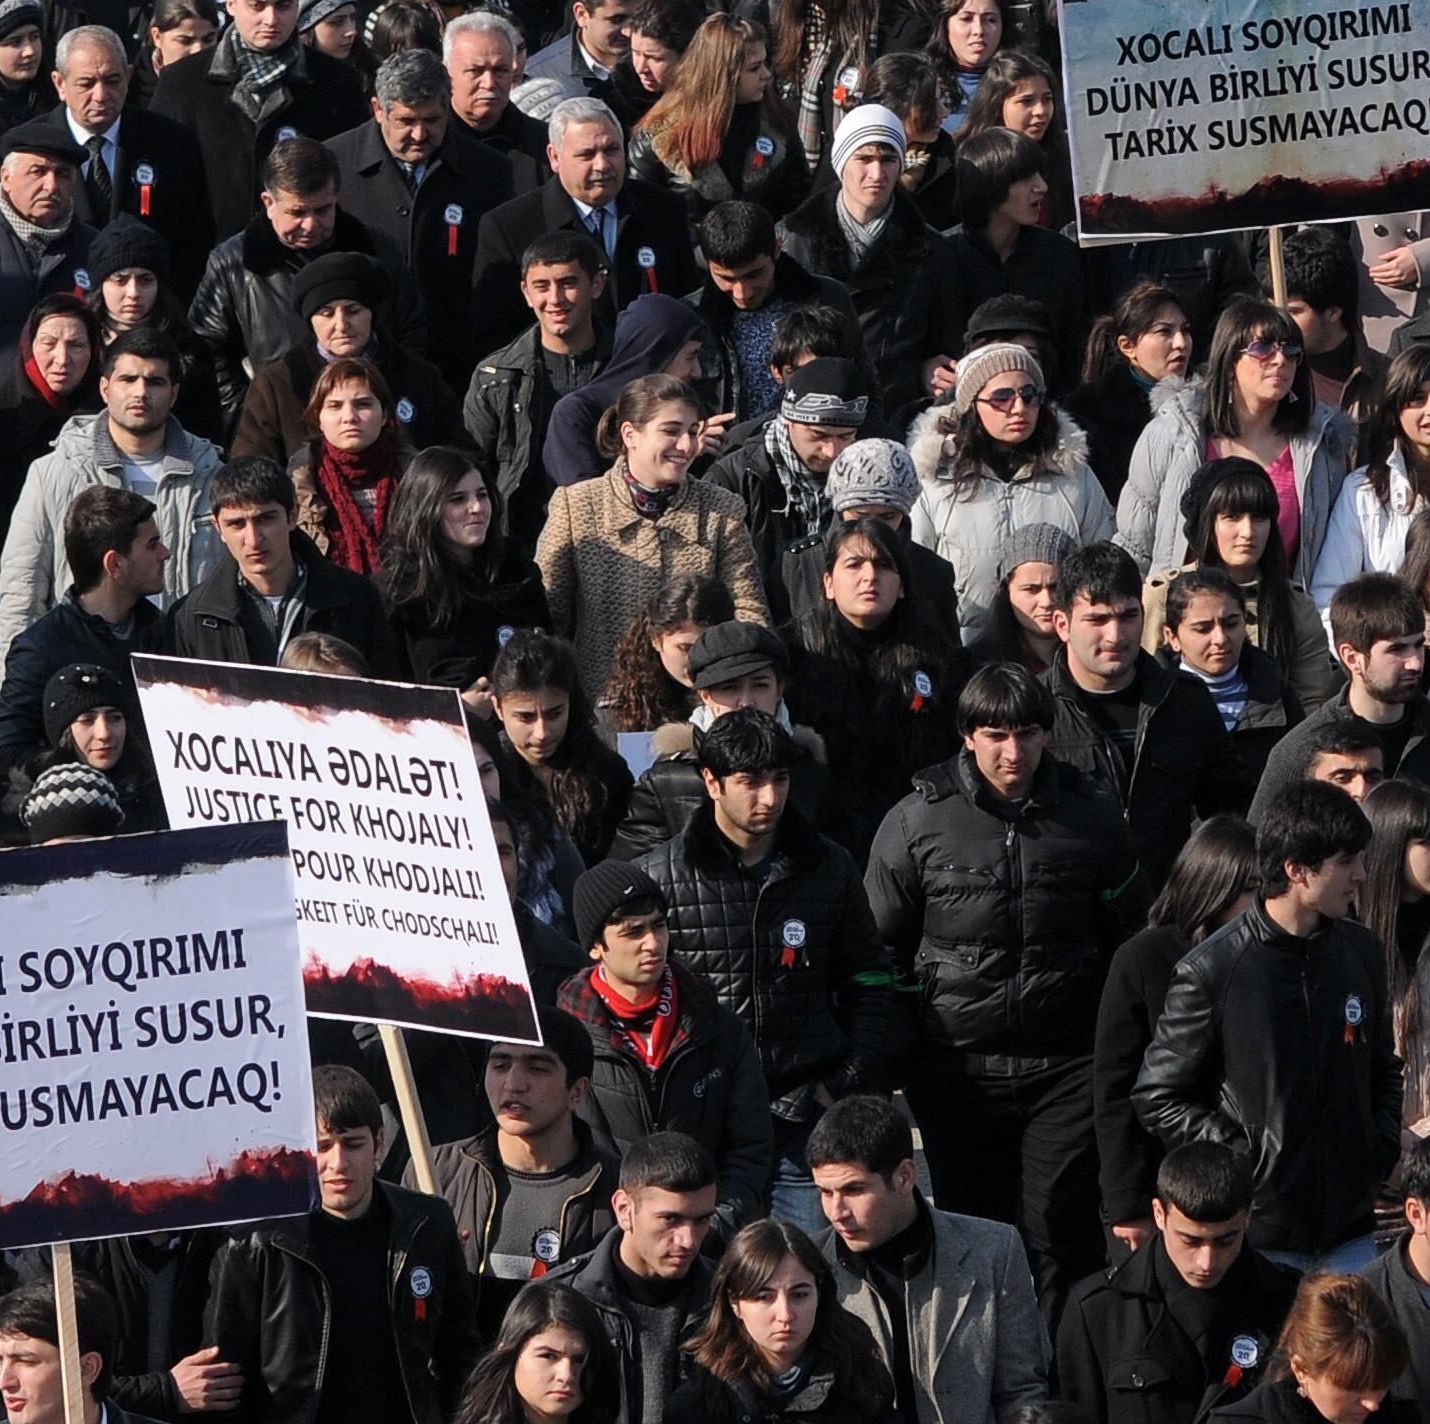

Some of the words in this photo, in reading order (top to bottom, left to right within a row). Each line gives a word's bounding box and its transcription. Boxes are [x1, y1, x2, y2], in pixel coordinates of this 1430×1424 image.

[1117, 24, 1233, 67] XOCALI
[1242, 3, 1412, 52] SOYQIRIMI
[1086, 77, 1199, 117] DÜNYA
[1210, 56, 1319, 104] BİRLİYİ
[1105, 119, 1198, 161] TARİX
[166, 730, 322, 783] XOCALIYA
[329, 746, 463, 802] ƏDALƏT!
[292, 796, 347, 835] FOR
[349, 802, 474, 851] KHOJALY!
[292, 849, 365, 884] POUR
[363, 857, 485, 901] KHODJALI!
[343, 899, 379, 929] FÜR
[382, 909, 500, 946] CHODSCHALI!
[20, 928, 246, 993] SOYQIRIMI
[134, 994, 286, 1048] SUSUR,
[541, 1246, 552, 1254] 20
